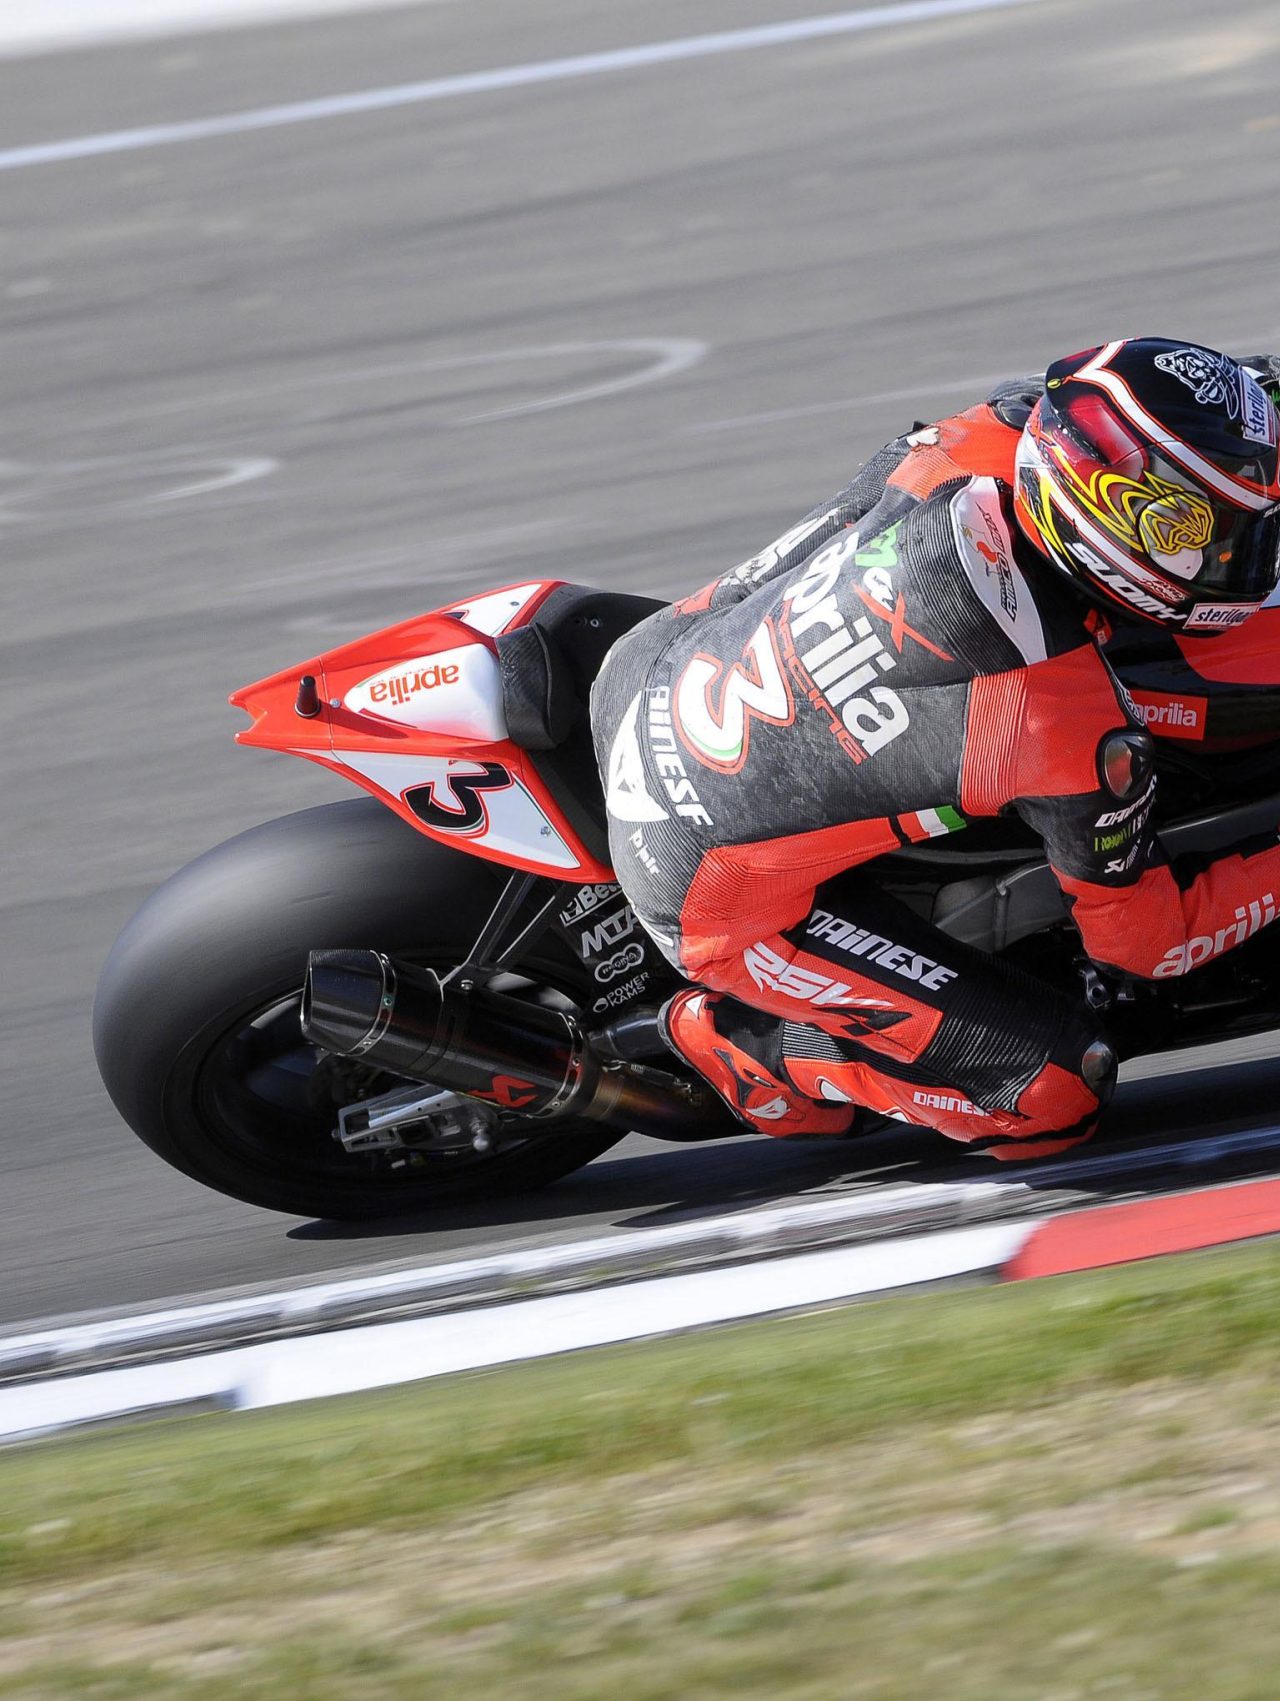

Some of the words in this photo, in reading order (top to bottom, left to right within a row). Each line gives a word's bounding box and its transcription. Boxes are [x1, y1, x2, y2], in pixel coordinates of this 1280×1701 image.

[1064, 541, 1188, 621] SUOMY
[782, 531, 910, 757] aprilia
[369, 663, 460, 705] aprilia
[672, 612, 796, 775] 3
[400, 760, 512, 839] 3
[606, 971, 651, 1000] POWER
[804, 909, 959, 992] DAINESE
[608, 985, 647, 1007] KAMS
